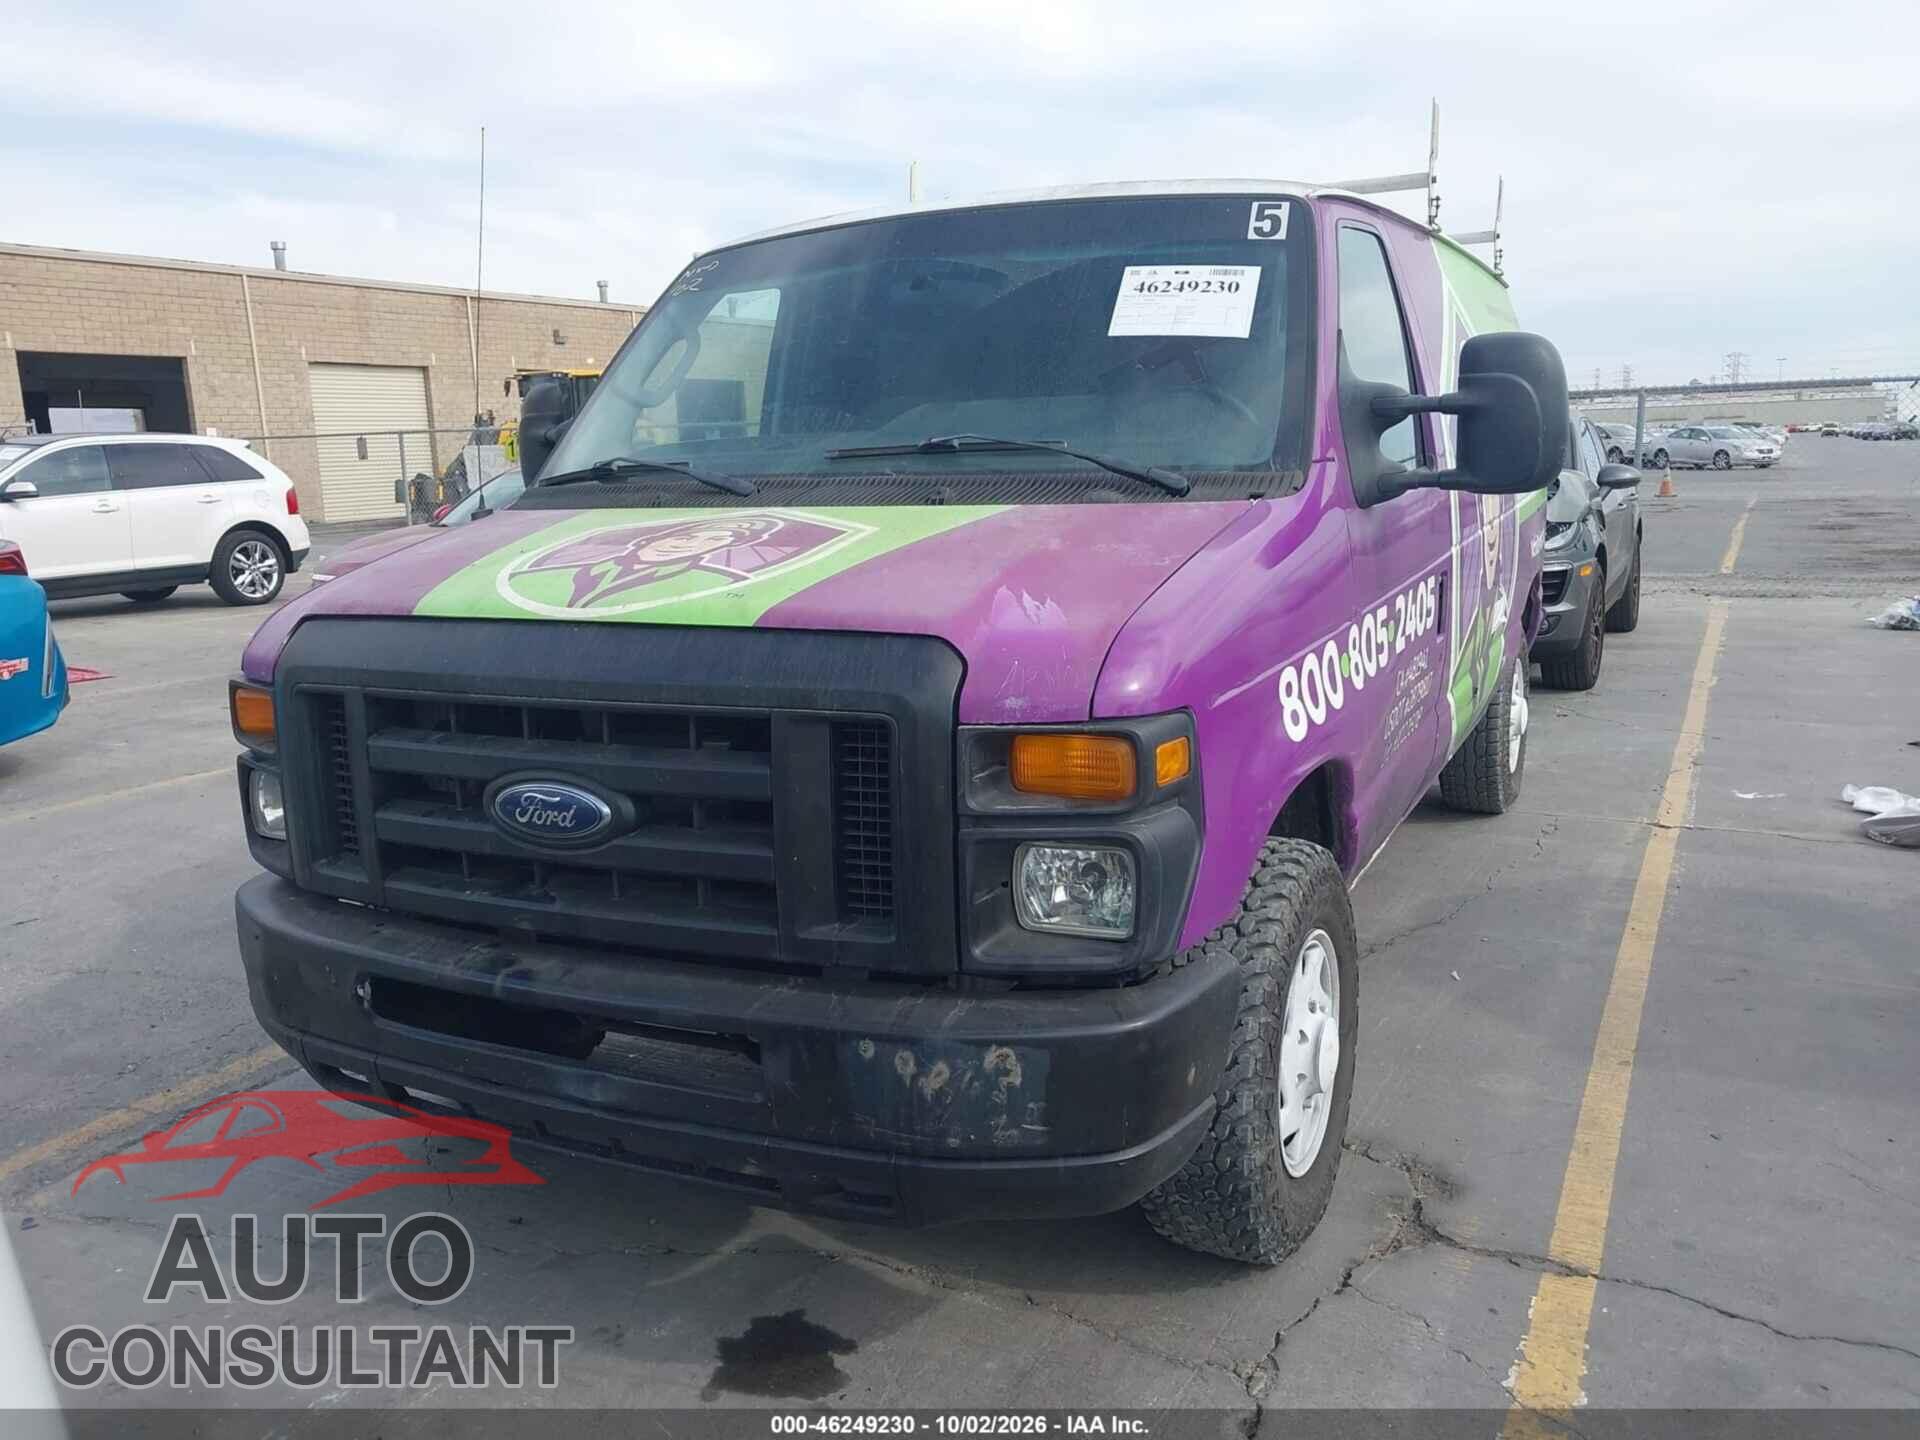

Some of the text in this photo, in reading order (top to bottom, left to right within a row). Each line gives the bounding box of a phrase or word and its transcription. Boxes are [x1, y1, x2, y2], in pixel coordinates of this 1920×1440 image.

[1252, 203, 1282, 238] 5
[1133, 280, 1240, 294] 46249230
[515, 792, 577, 828] Ford
